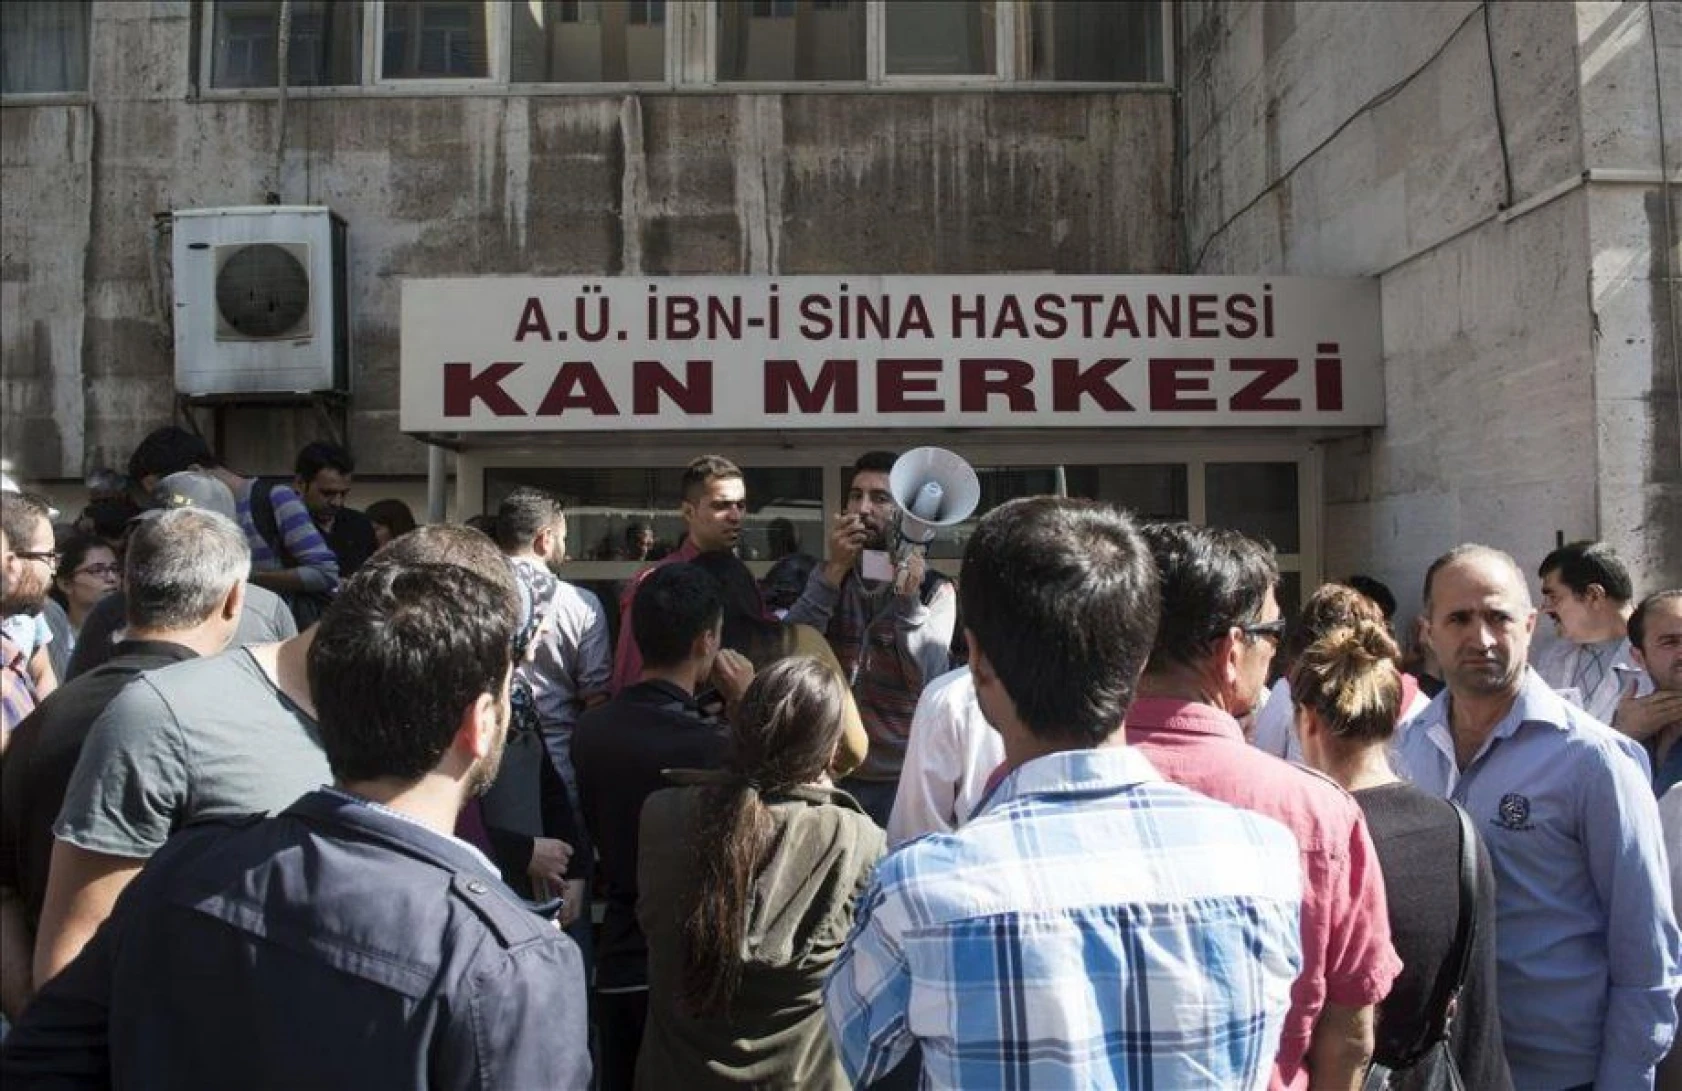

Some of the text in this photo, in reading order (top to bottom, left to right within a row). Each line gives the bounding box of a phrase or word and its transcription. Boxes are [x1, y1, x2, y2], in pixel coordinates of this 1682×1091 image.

[514, 283, 1274, 342] A.Ü. İBN-İ SİNA HASTANESİ
[444, 342, 1344, 417] KAN MERKEZİ
